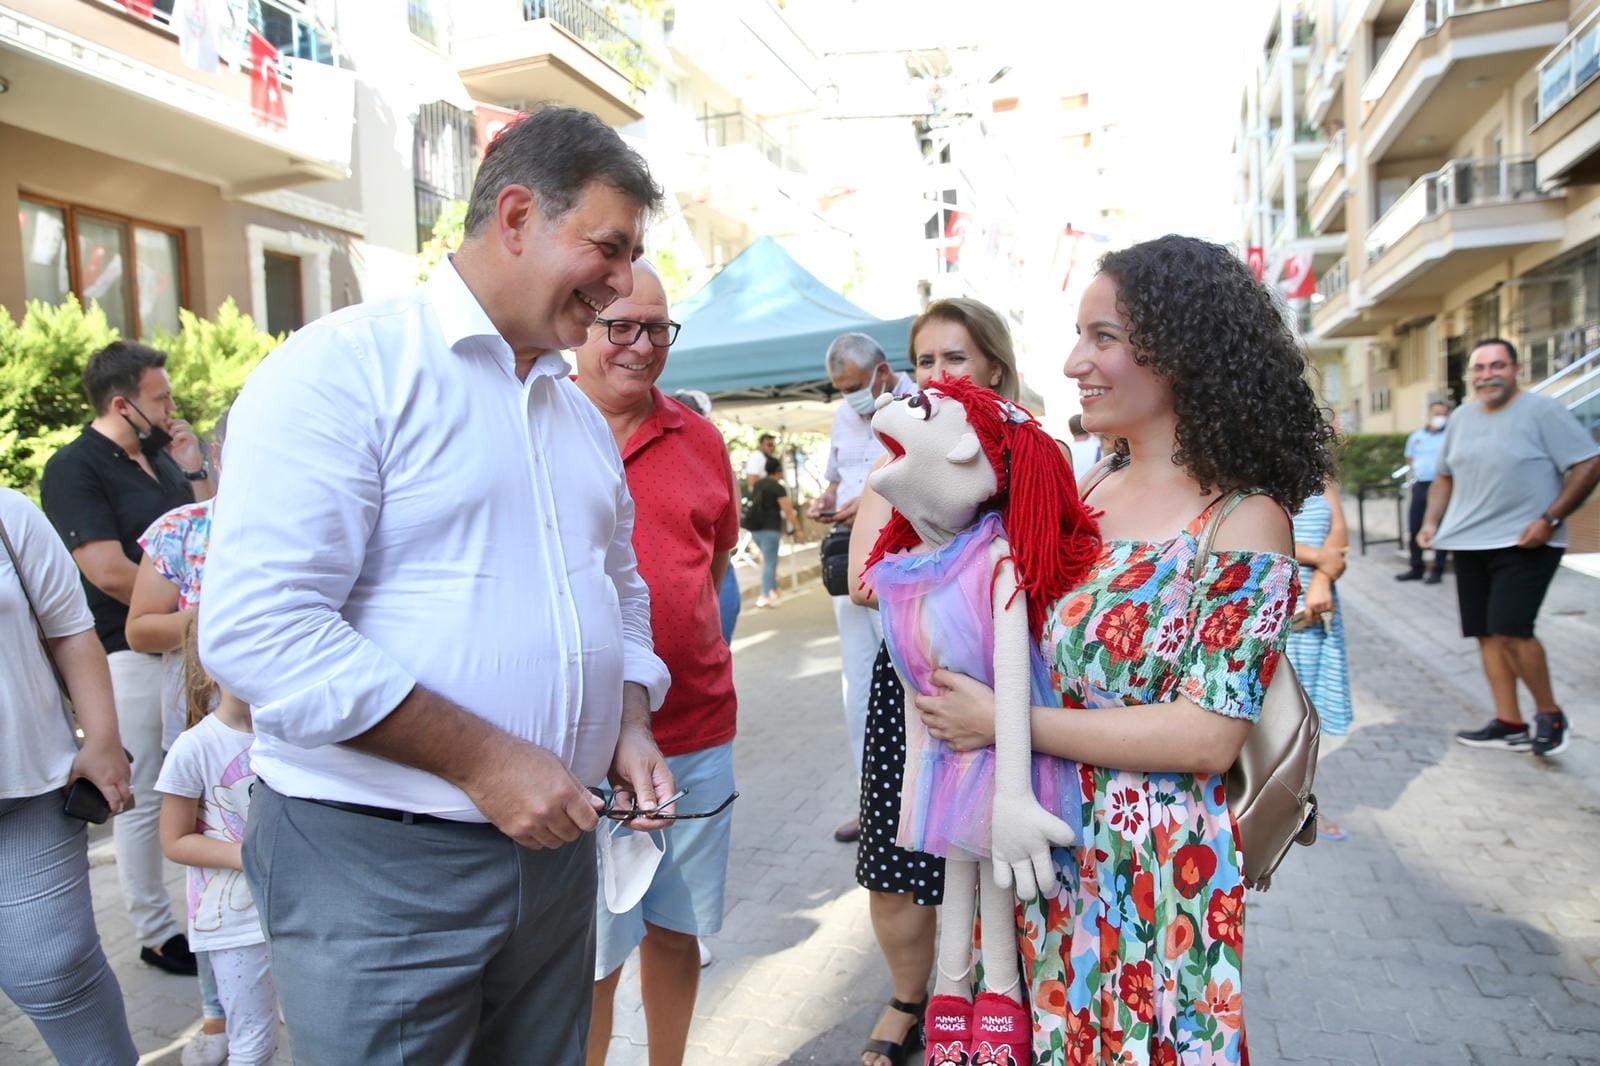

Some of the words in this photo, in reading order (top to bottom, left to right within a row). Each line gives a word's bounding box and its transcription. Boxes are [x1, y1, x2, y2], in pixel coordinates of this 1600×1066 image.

[935, 1015, 966, 1023] MINNIE
[981, 1015, 1014, 1024] MINNIE
[935, 1023, 966, 1031] MOUSE
[981, 1024, 1014, 1032] MOUSE
